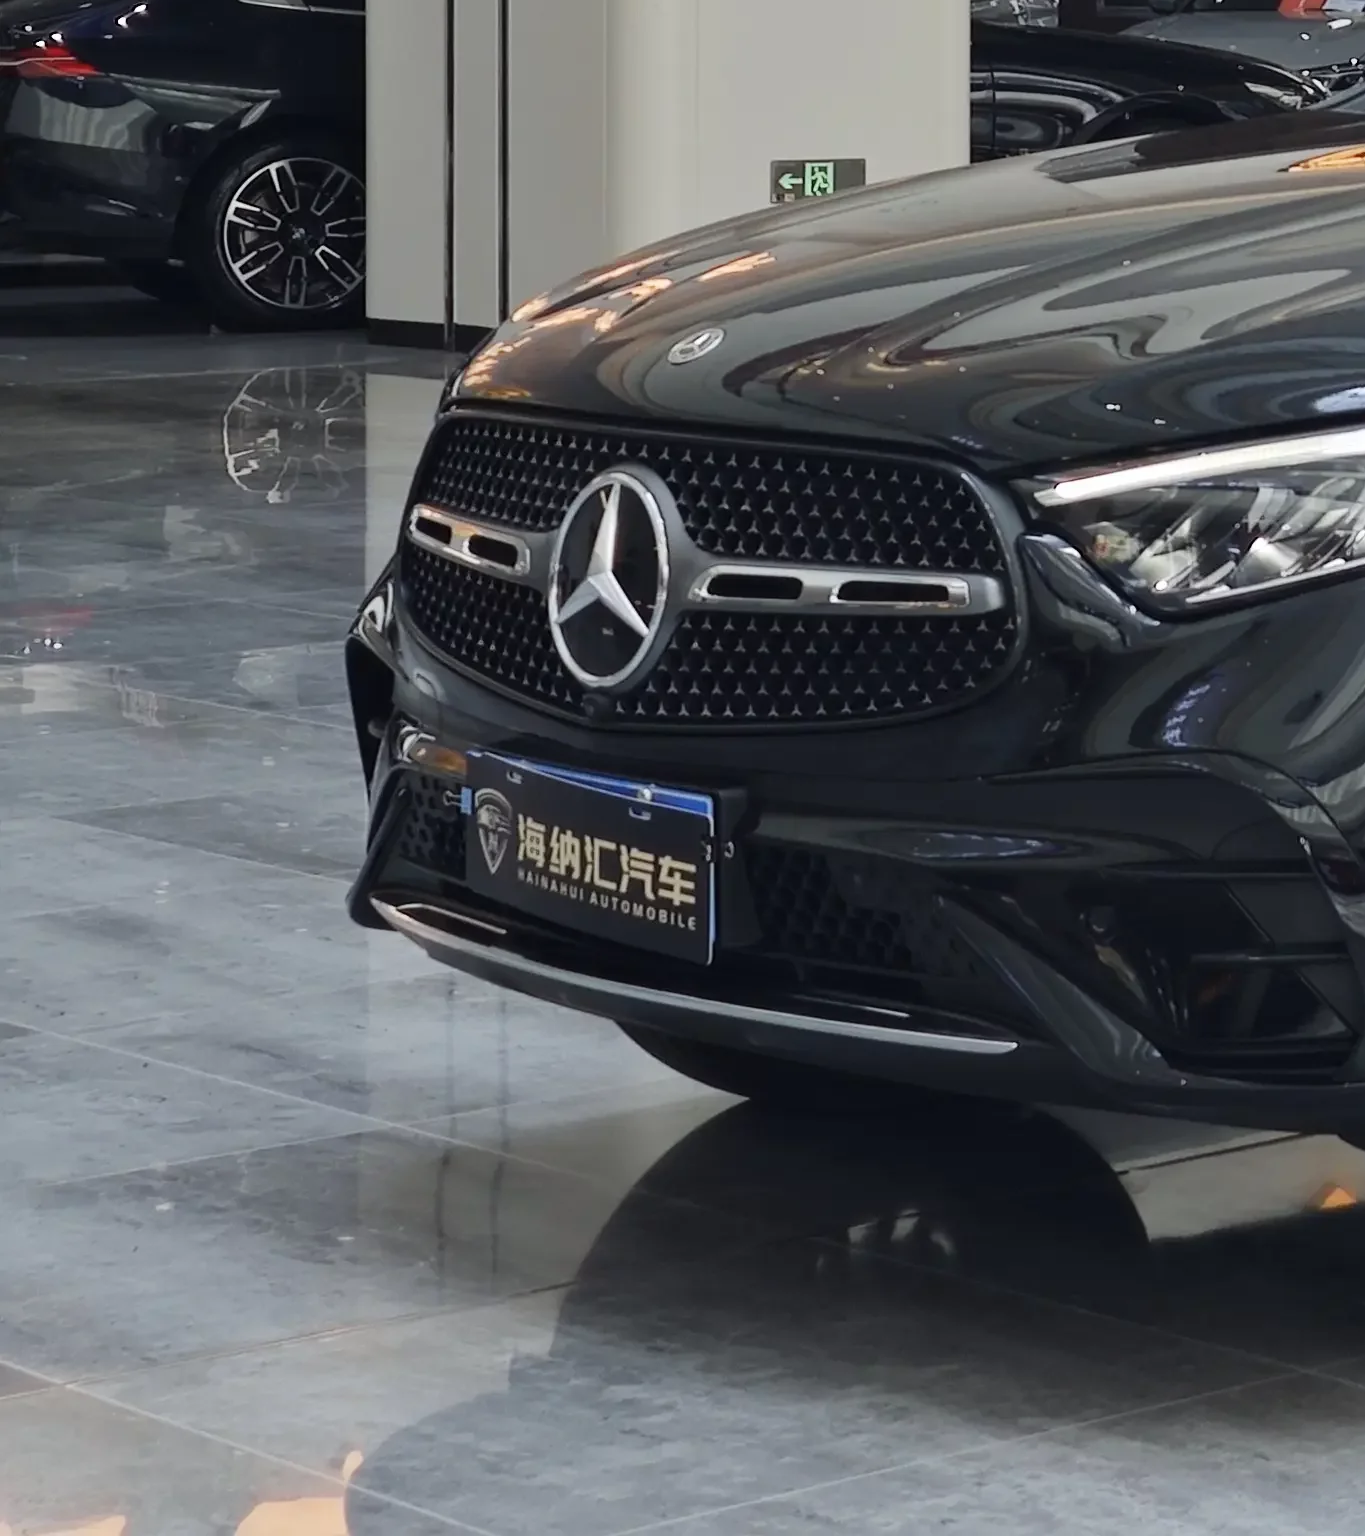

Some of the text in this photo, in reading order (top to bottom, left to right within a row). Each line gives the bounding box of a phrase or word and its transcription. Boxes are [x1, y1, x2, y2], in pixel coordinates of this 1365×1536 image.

[516, 813, 697, 909] 海纳汇汽车
[516, 867, 698, 932] HAINAHUI AUTOMOBILE
